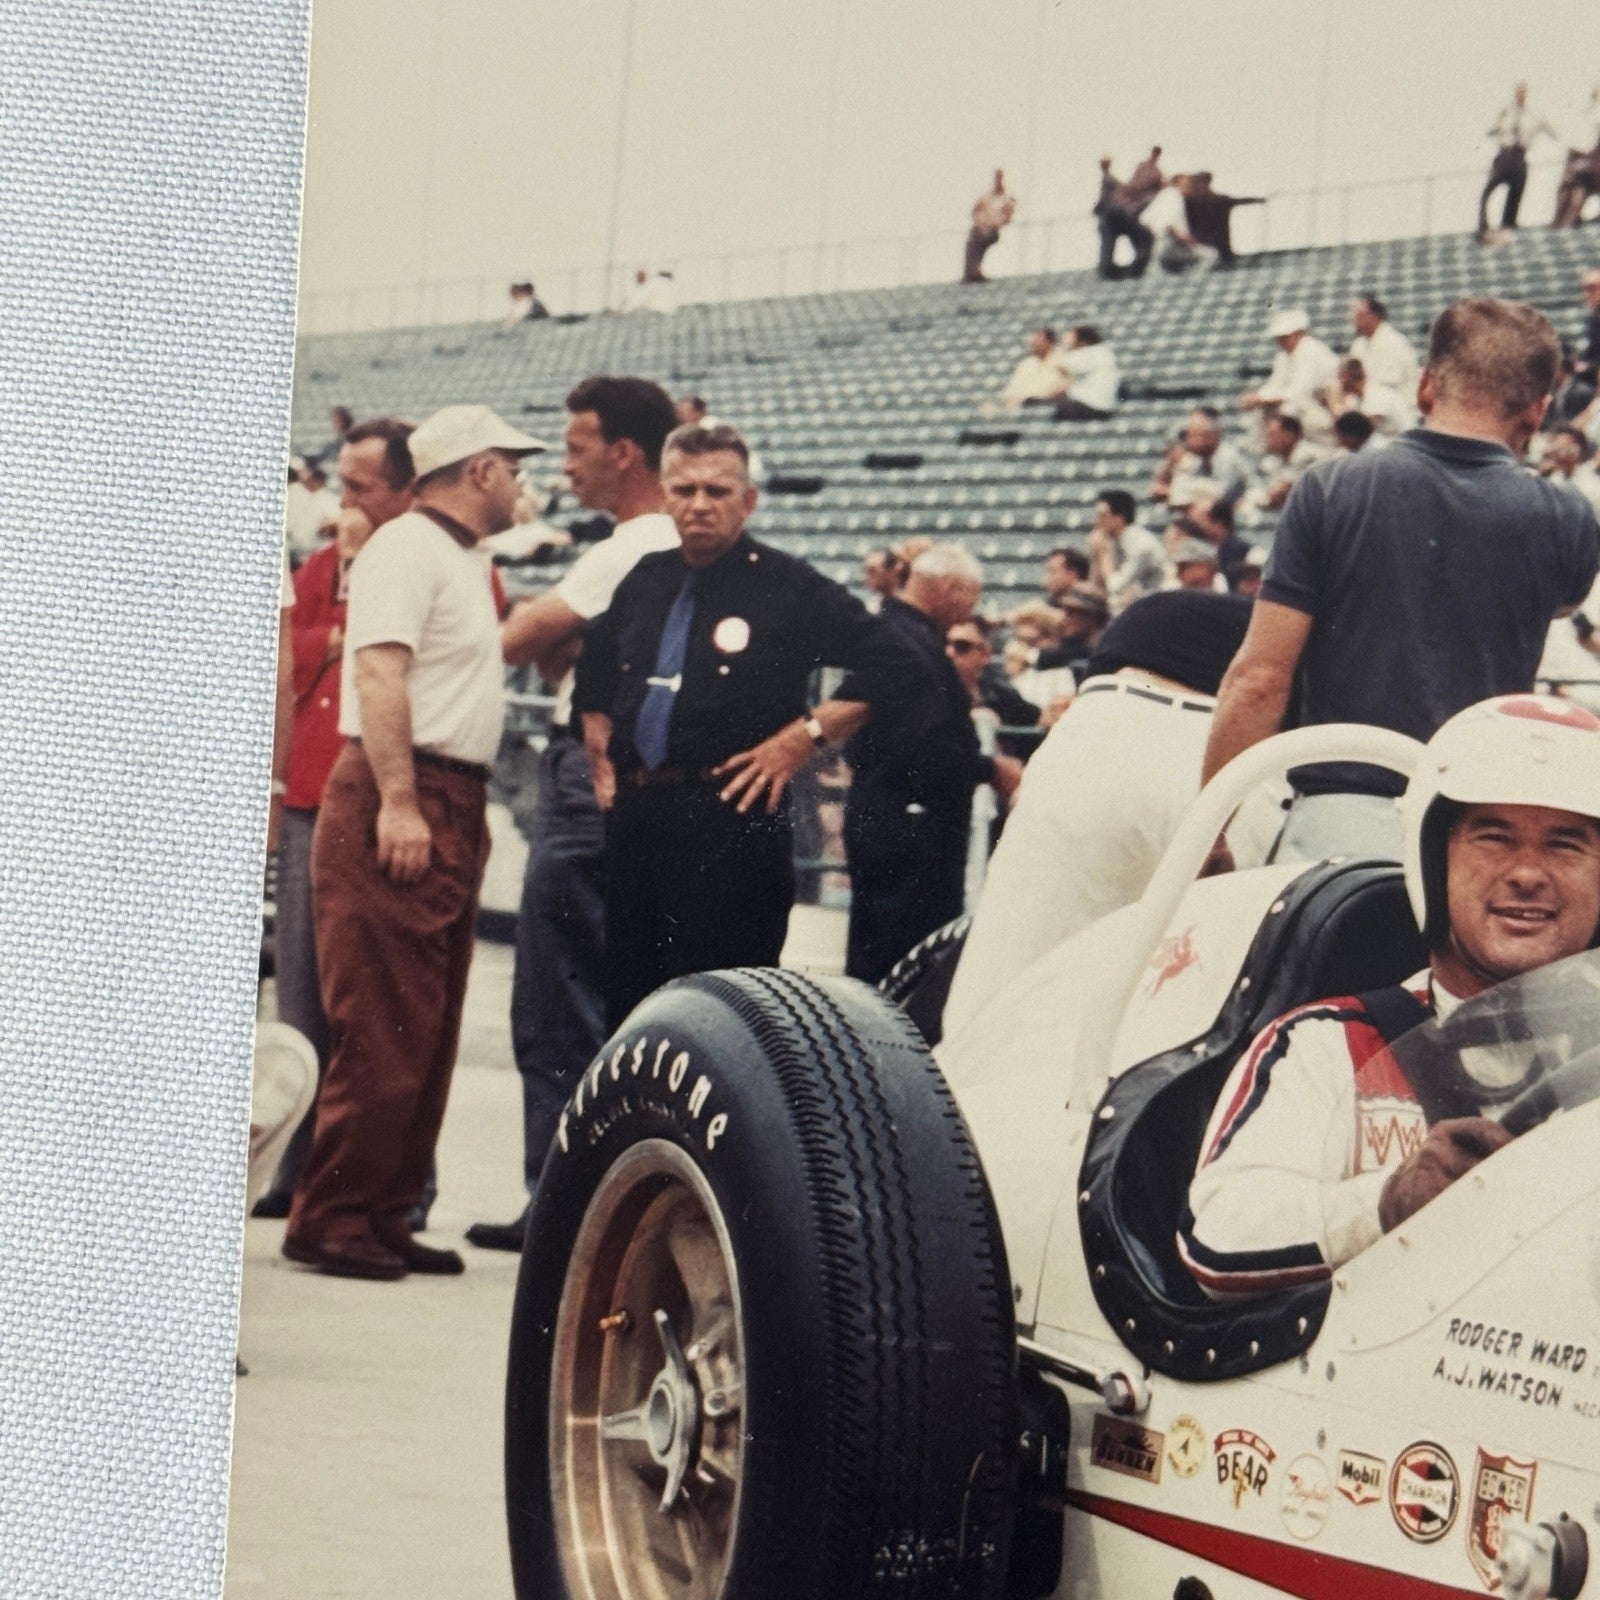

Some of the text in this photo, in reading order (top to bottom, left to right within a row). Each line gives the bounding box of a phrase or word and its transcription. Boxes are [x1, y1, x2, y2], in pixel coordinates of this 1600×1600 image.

[1446, 1317, 1588, 1374] RODGER WARD
[1216, 1450, 1268, 1496] BEAR
[1341, 1459, 1381, 1487] Mobil
